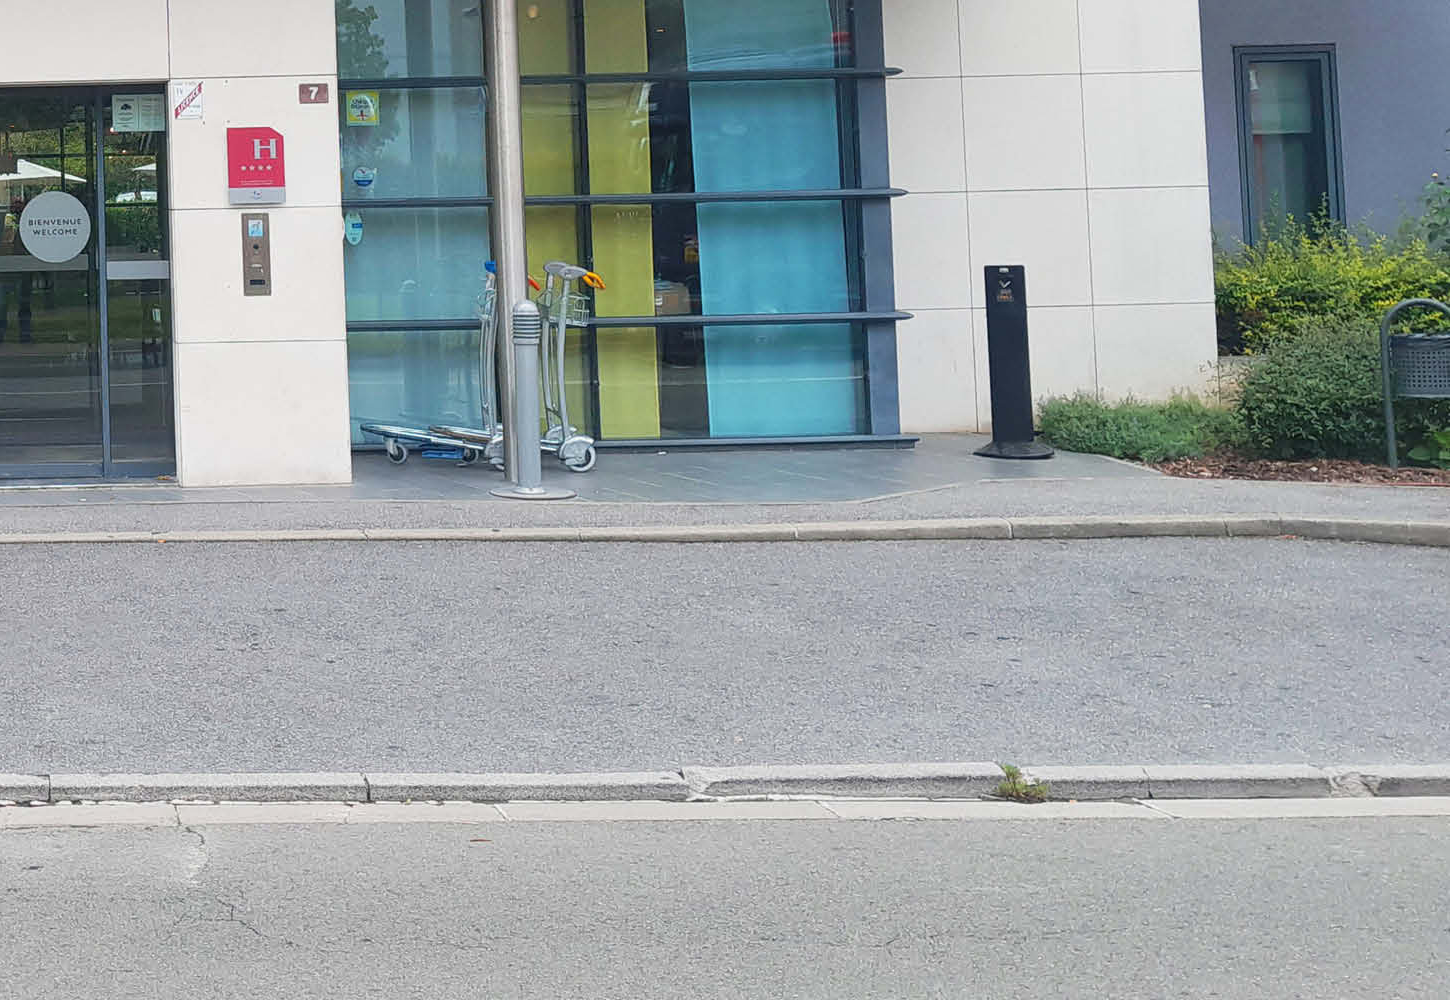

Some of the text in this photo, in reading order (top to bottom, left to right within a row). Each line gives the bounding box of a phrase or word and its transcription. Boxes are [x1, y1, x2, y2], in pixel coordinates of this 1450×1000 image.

[309, 86, 319, 101] 7
[253, 138, 278, 160] H
[28, 218, 82, 226] BIENVENUE
[32, 228, 78, 236] WELCOME
